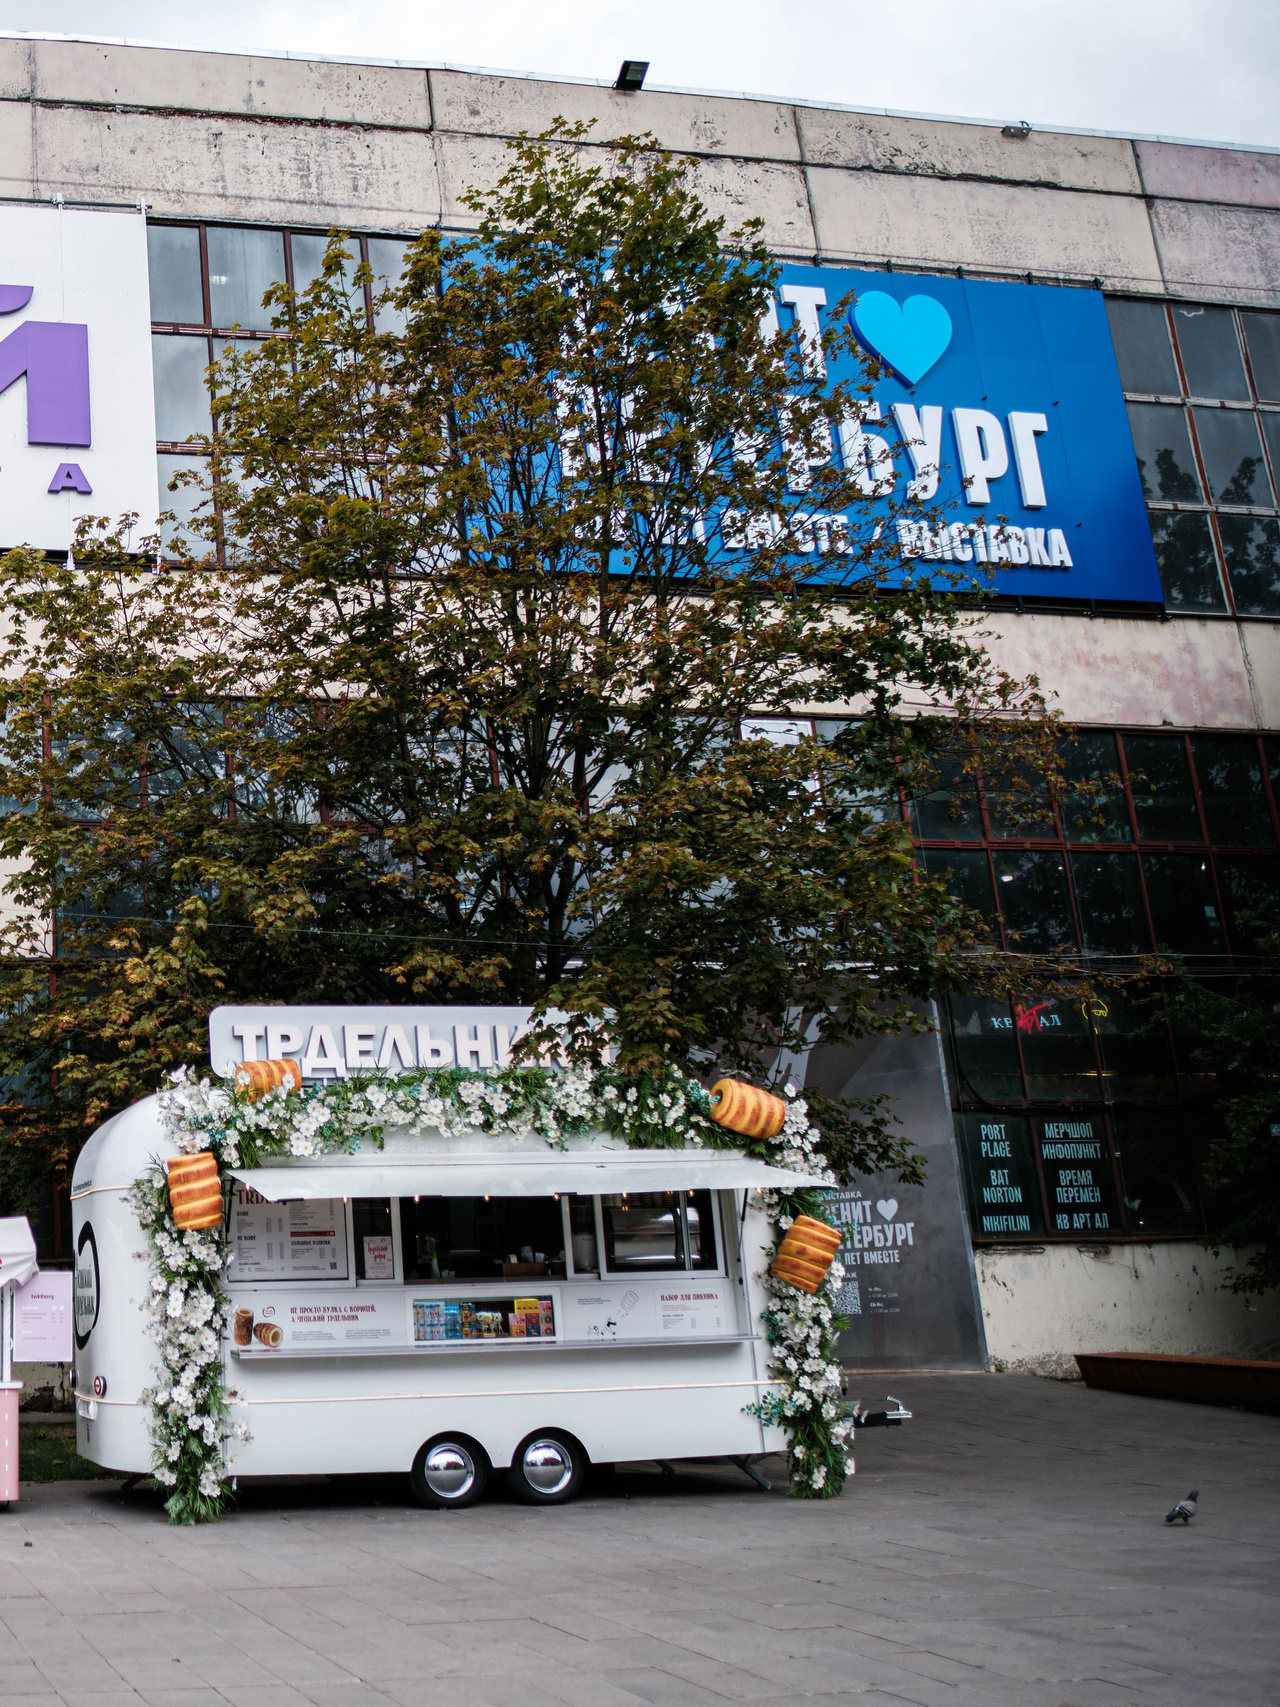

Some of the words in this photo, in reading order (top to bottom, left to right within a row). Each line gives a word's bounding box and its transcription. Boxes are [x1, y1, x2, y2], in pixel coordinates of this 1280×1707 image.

[232, 1023, 613, 1079] ТРДЕЛЬНИК
[980, 1124, 1006, 1140] PORT
[1044, 1122, 1093, 1139] МЕРЧШОП
[980, 1141, 1012, 1158] PLACE
[1041, 1143, 1101, 1160] ИНФОПУНКТ
[990, 1169, 1009, 1186] BAT
[1058, 1169, 1093, 1186] ВРЕМЯ
[982, 1186, 1023, 1204] NORTON
[1055, 1186, 1101, 1204] ПЕРЕМЕН
[982, 1214, 1031, 1232] NIKIFILINI
[833, 1221, 915, 1250] ТЕРБУРГ
[844, 1252, 860, 1266] ЛЕТ
[863, 1249, 900, 1265] ВМЕСТЕ
[299, 1306, 322, 1314] ПРОСТО
[322, 1305, 343, 1313] БУЛКА
